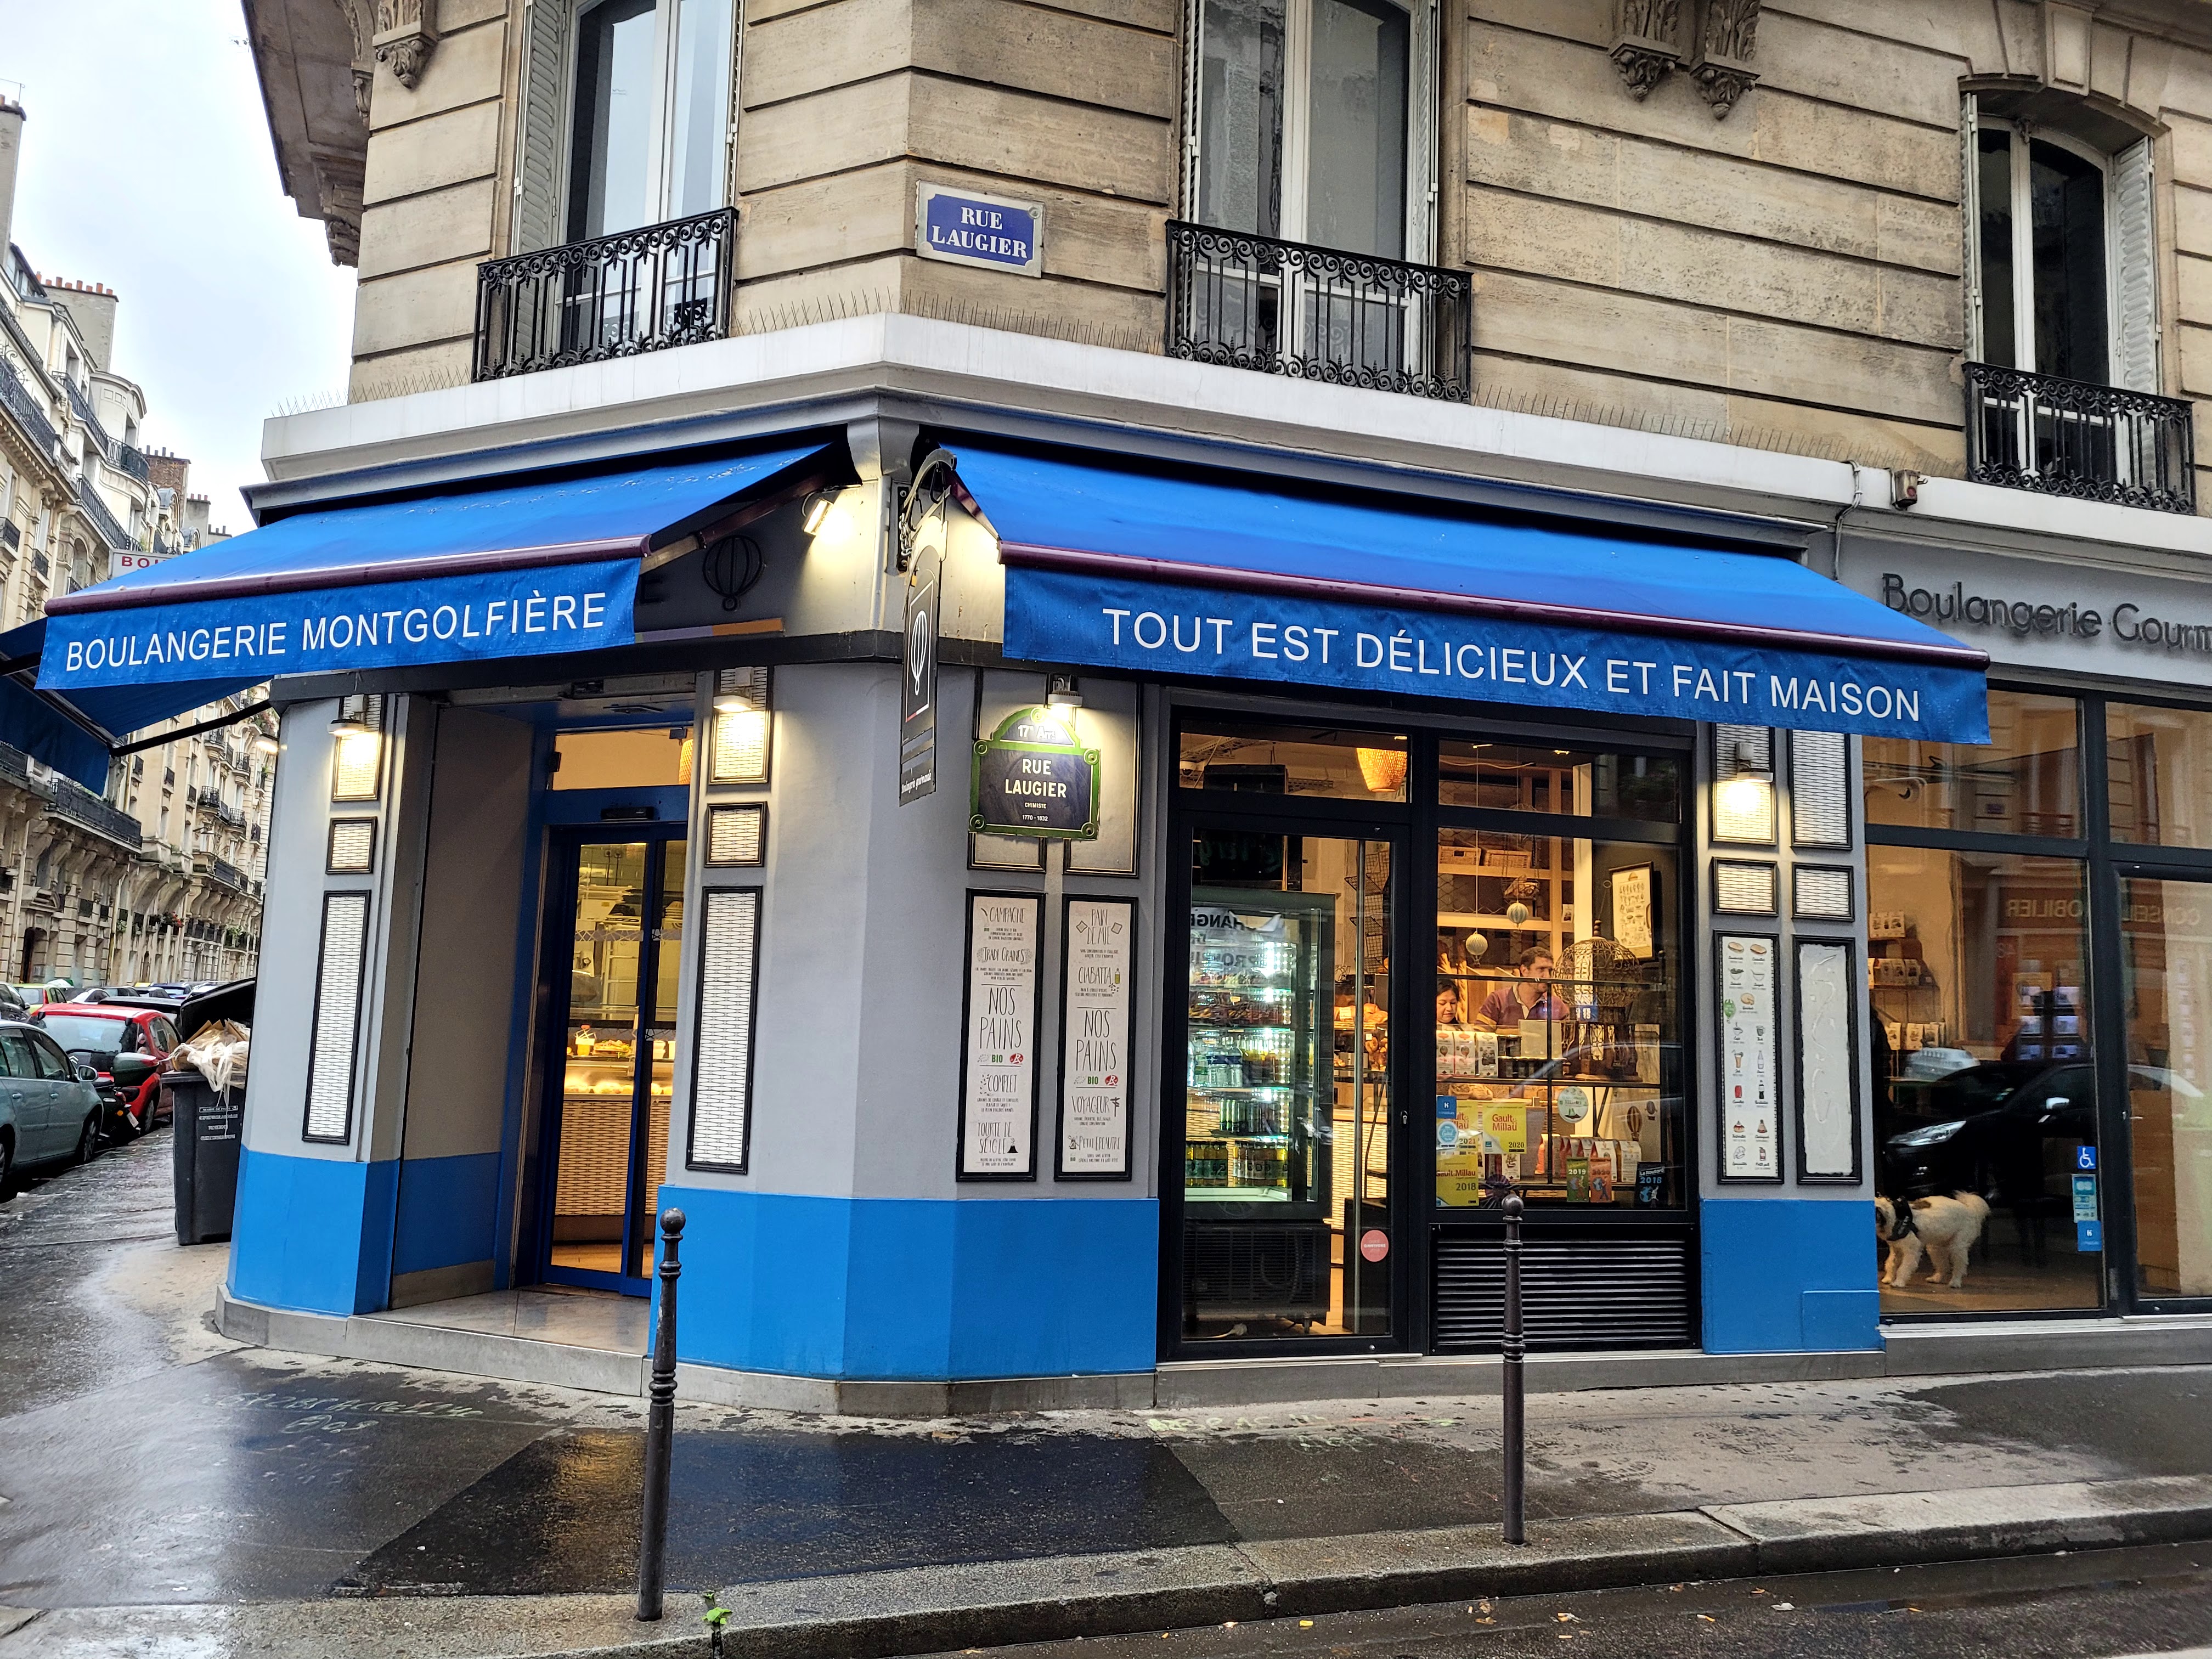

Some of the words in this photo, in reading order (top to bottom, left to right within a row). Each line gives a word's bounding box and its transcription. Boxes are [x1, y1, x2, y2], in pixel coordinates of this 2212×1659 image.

[961, 206, 1002, 230] RUE
[932, 225, 1028, 258] LAUGIER
[1882, 573, 2102, 638] Boulangerie
[65, 622, 287, 672] BOULANGERIE
[302, 590, 607, 651] MONTGOLFIÈRE
[1102, 608, 1233, 654] TOUT
[1252, 622, 1339, 664] EST
[1356, 629, 1588, 689] DÉLICIEUX
[1606, 659, 1657, 695] ET
[1673, 665, 1756, 704] FAIT
[1770, 675, 1920, 721] MAISON
[1022, 758, 1052, 775] RUE
[1005, 778, 1067, 798] LAUGIER
[990, 907, 1026, 923] CAMPAGNE
[1091, 909, 1108, 926] PAIN
[1087, 927, 1096, 945] DE
[1098, 926, 1111, 945] MIE
[983, 947, 999, 961] TRADI
[1002, 947, 1024, 962] GRAINES
[1078, 967, 1111, 984] CIABATTA
[989, 986, 1015, 1015] NOS
[1085, 1009, 1110, 1037] NOS
[980, 1017, 1022, 1049] PAINS
[991, 1054, 1003, 1063] BIO
[1076, 1039, 1116, 1071] PAINS
[988, 1074, 1017, 1093] COMPLET
[1087, 1076, 1099, 1085] BIO
[1071, 1096, 1110, 1114] VOYAGEUR
[978, 1122, 1001, 1137] TOURTE
[1004, 1121, 1012, 1137] DE
[1492, 1122, 1517, 1131] Millau
[1079, 1136, 1094, 1150] PETIT
